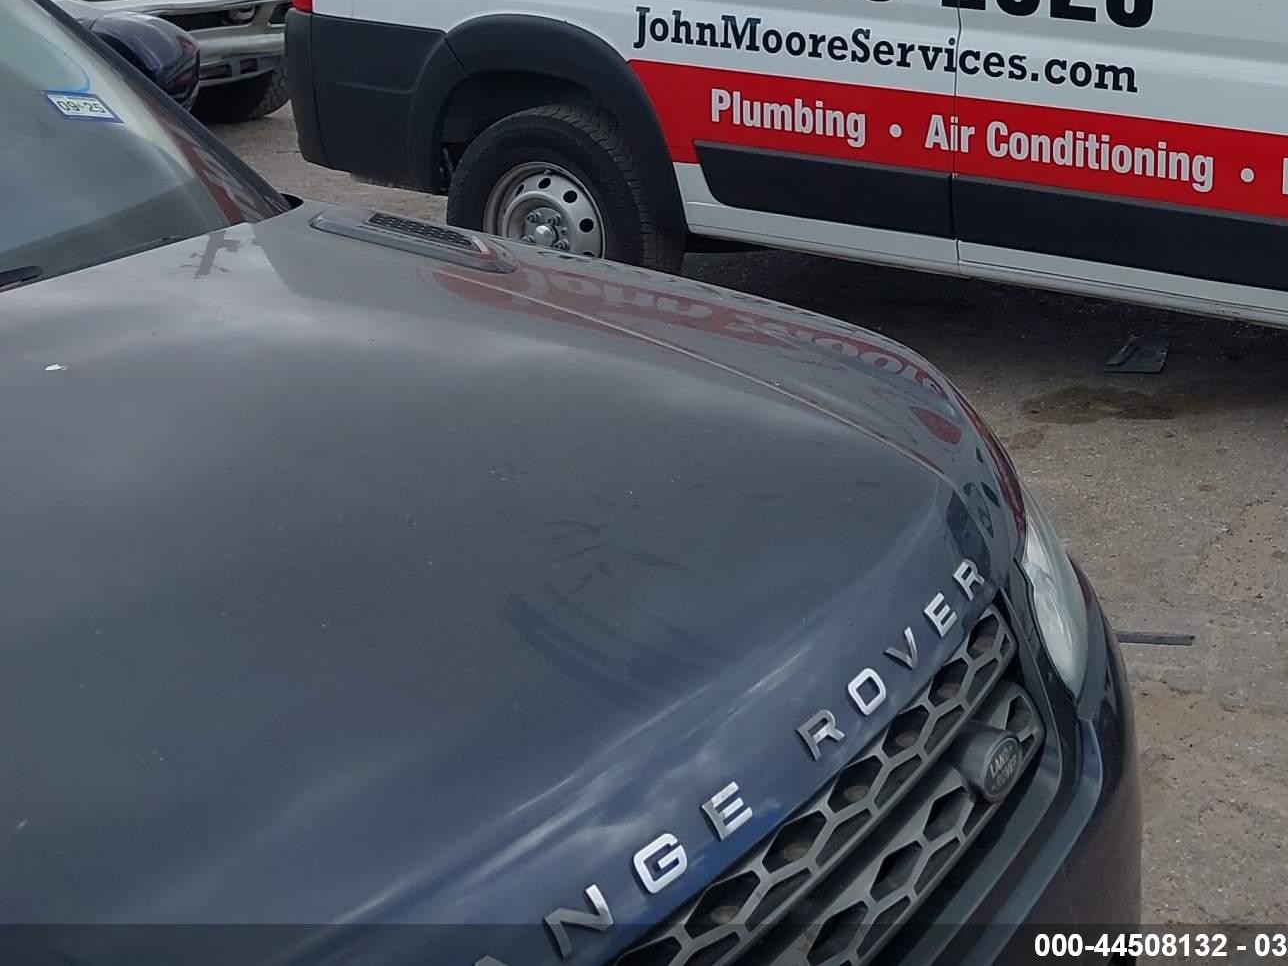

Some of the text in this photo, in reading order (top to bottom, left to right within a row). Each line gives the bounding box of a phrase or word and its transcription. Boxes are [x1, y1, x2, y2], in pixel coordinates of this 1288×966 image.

[633, 6, 1139, 94] JohnMooreServices.com
[710, 89, 867, 149] Plumbing
[925, 114, 976, 153] Air
[986, 121, 1215, 193] Conditioning
[795, 559, 985, 761] ROVER
